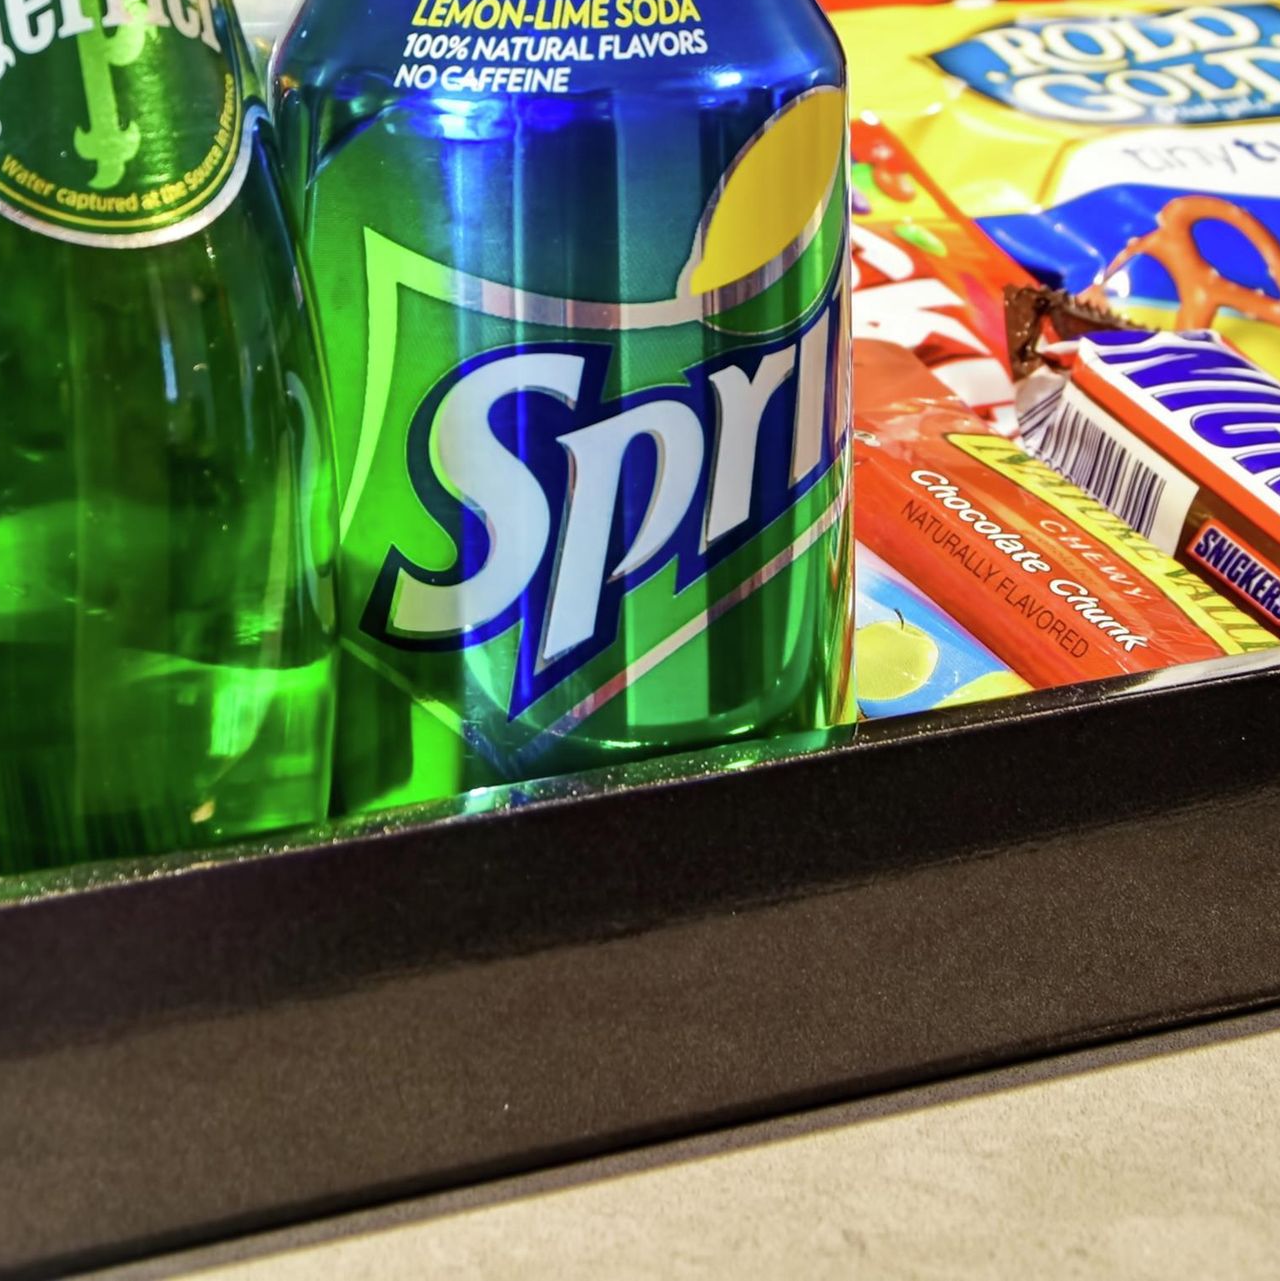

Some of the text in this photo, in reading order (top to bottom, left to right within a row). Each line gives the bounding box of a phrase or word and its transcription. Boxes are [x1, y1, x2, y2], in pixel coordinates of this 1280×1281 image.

[402, 28, 709, 62] 100% NATURAL FLAVORS
[978, 6, 1261, 76] ROLD
[392, 63, 572, 94] NO CAFFEINE
[1, 153, 55, 197] Water
[56, 186, 138, 213] captured
[141, 191, 162, 210] at
[160, 180, 187, 204] the
[899, 499, 1001, 584] NATURALLY
[995, 575, 1090, 660] FLAVORED
[909, 468, 1053, 574] Chocolate
[1048, 577, 1151, 654] Chunk
[1038, 519, 1152, 602] CHEWY
